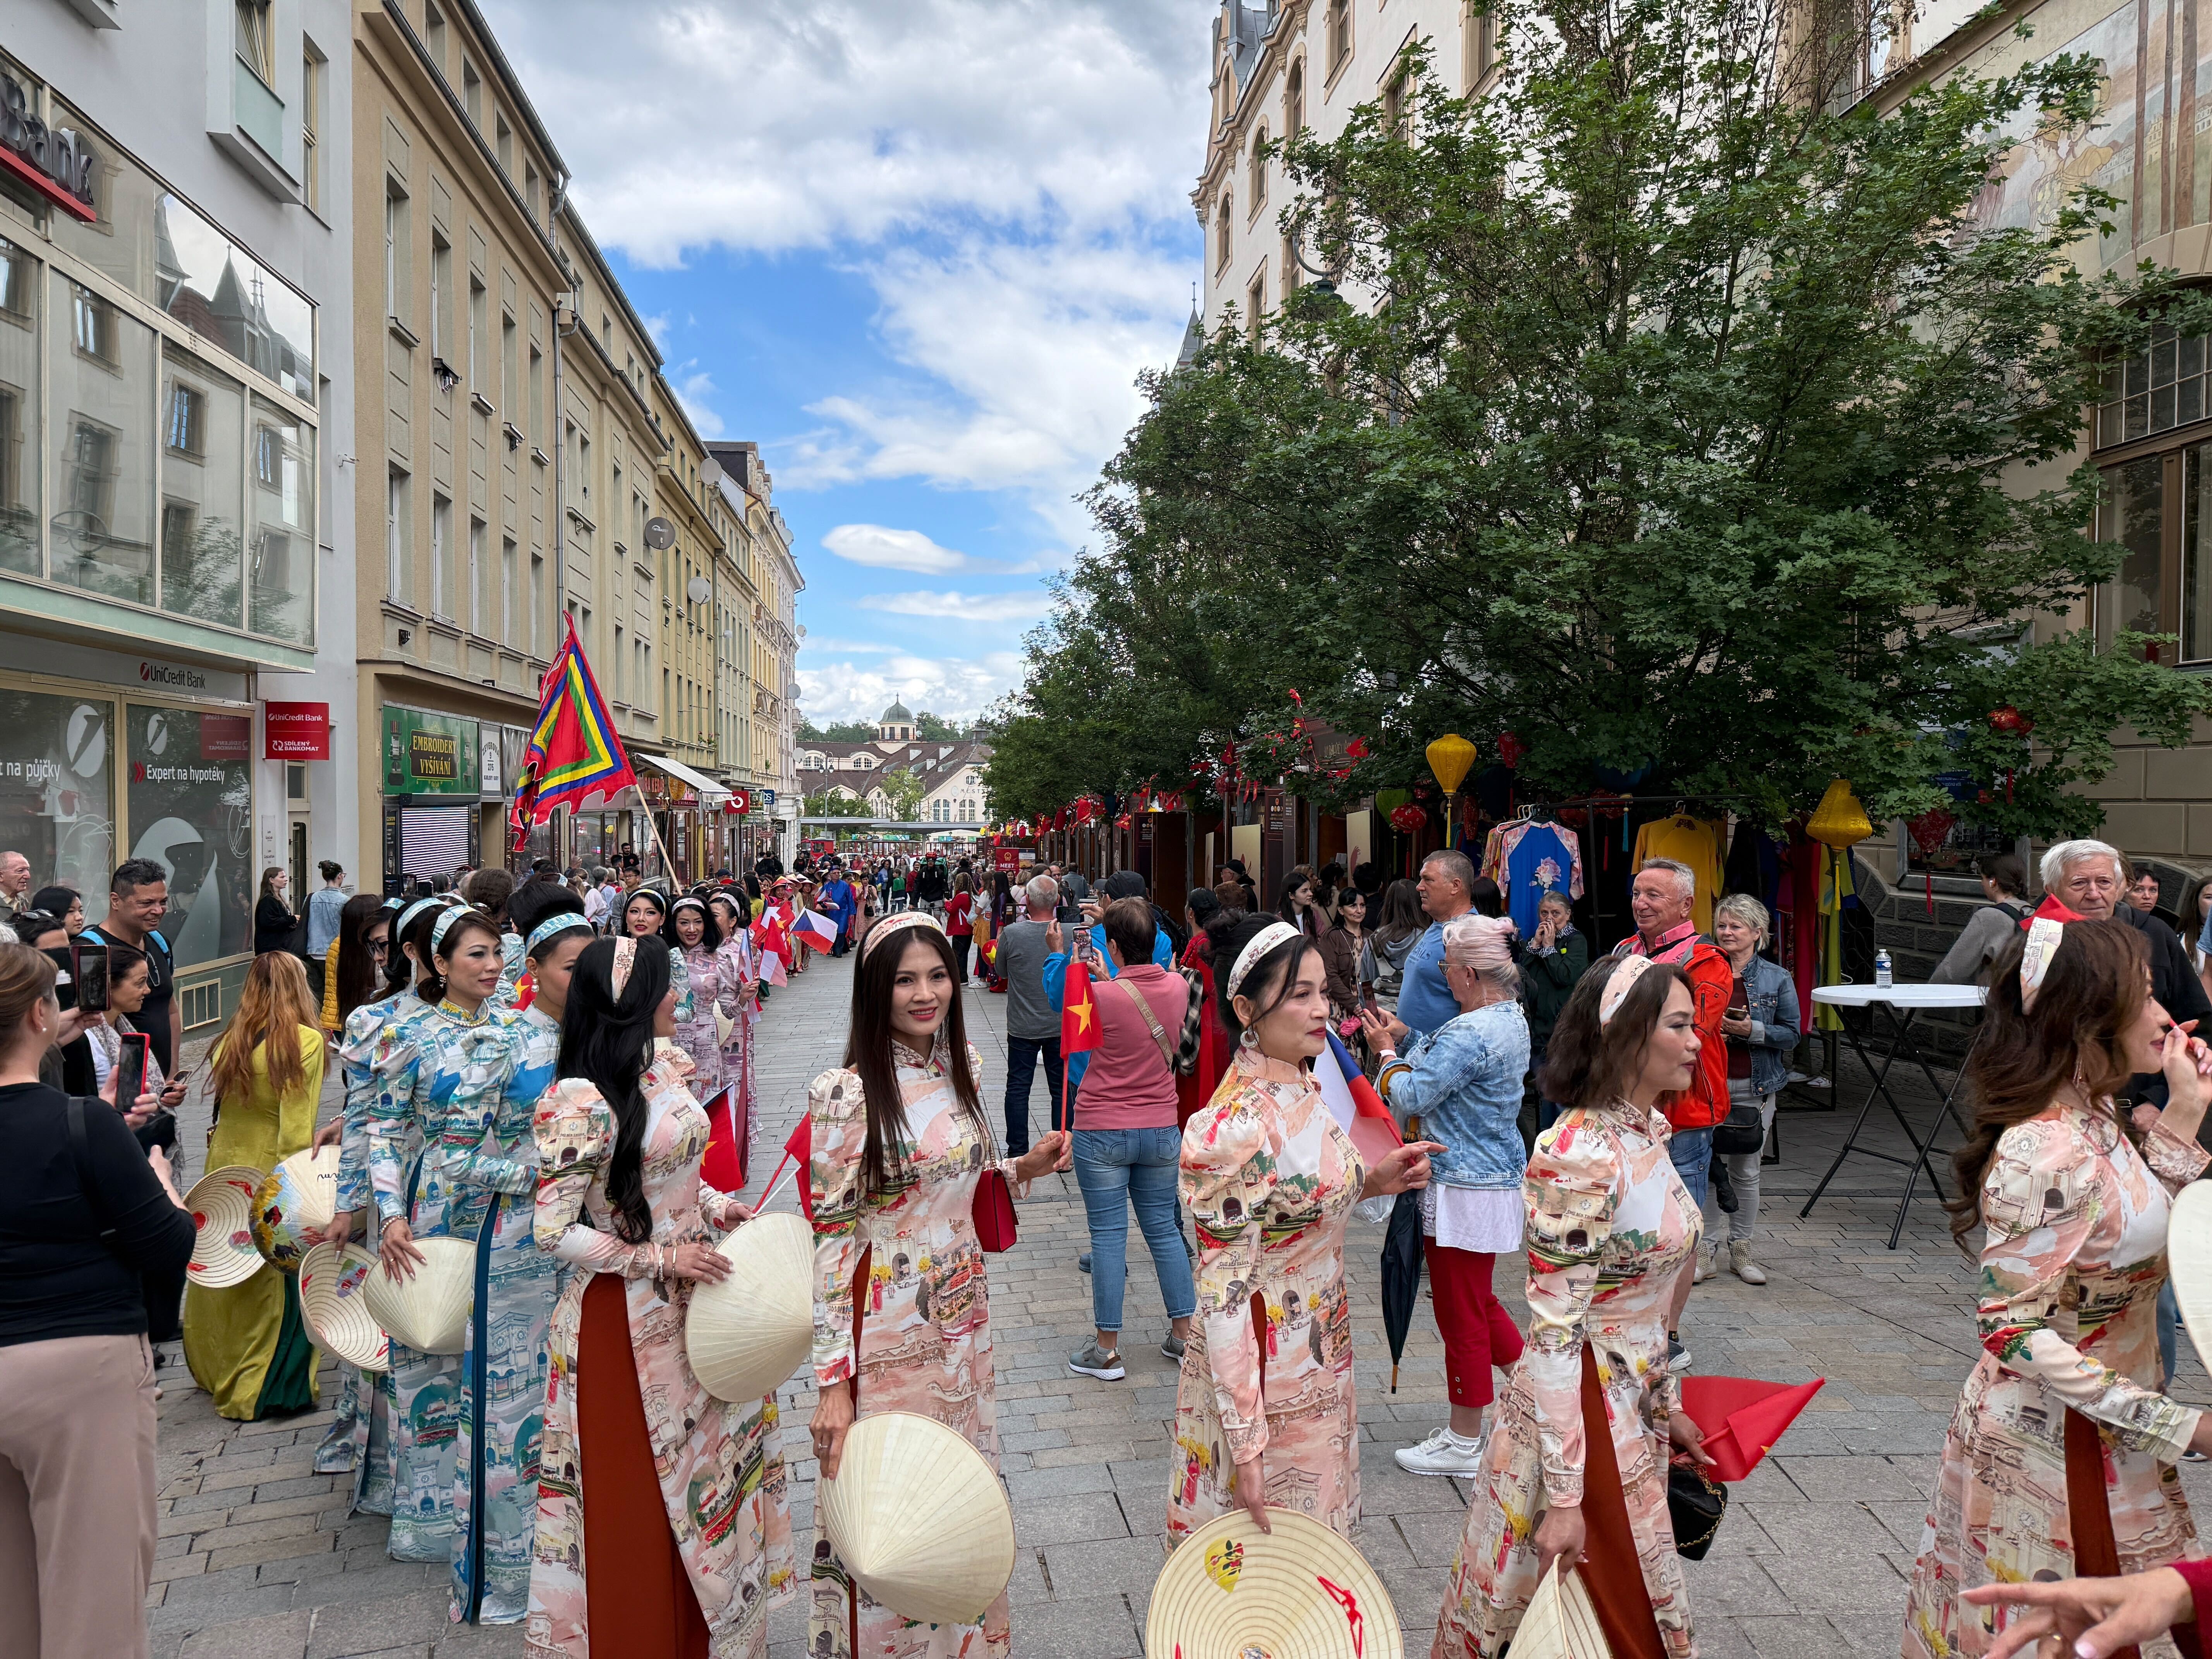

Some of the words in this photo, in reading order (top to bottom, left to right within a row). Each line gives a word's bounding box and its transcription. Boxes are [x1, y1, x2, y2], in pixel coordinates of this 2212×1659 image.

[0, 72, 94, 205] Bank
[151, 665, 185, 686] UniCredit
[187, 671, 206, 689] Bank
[413, 735, 457, 754] EMBROIDERY
[7, 762, 21, 776] na
[26, 758, 60, 781] půjčky
[147, 764, 176, 783] Expert
[177, 769, 187, 780] na
[190, 765, 225, 785] hypotéky
[420, 756, 450, 775] VYŠÍVÁNÍ
